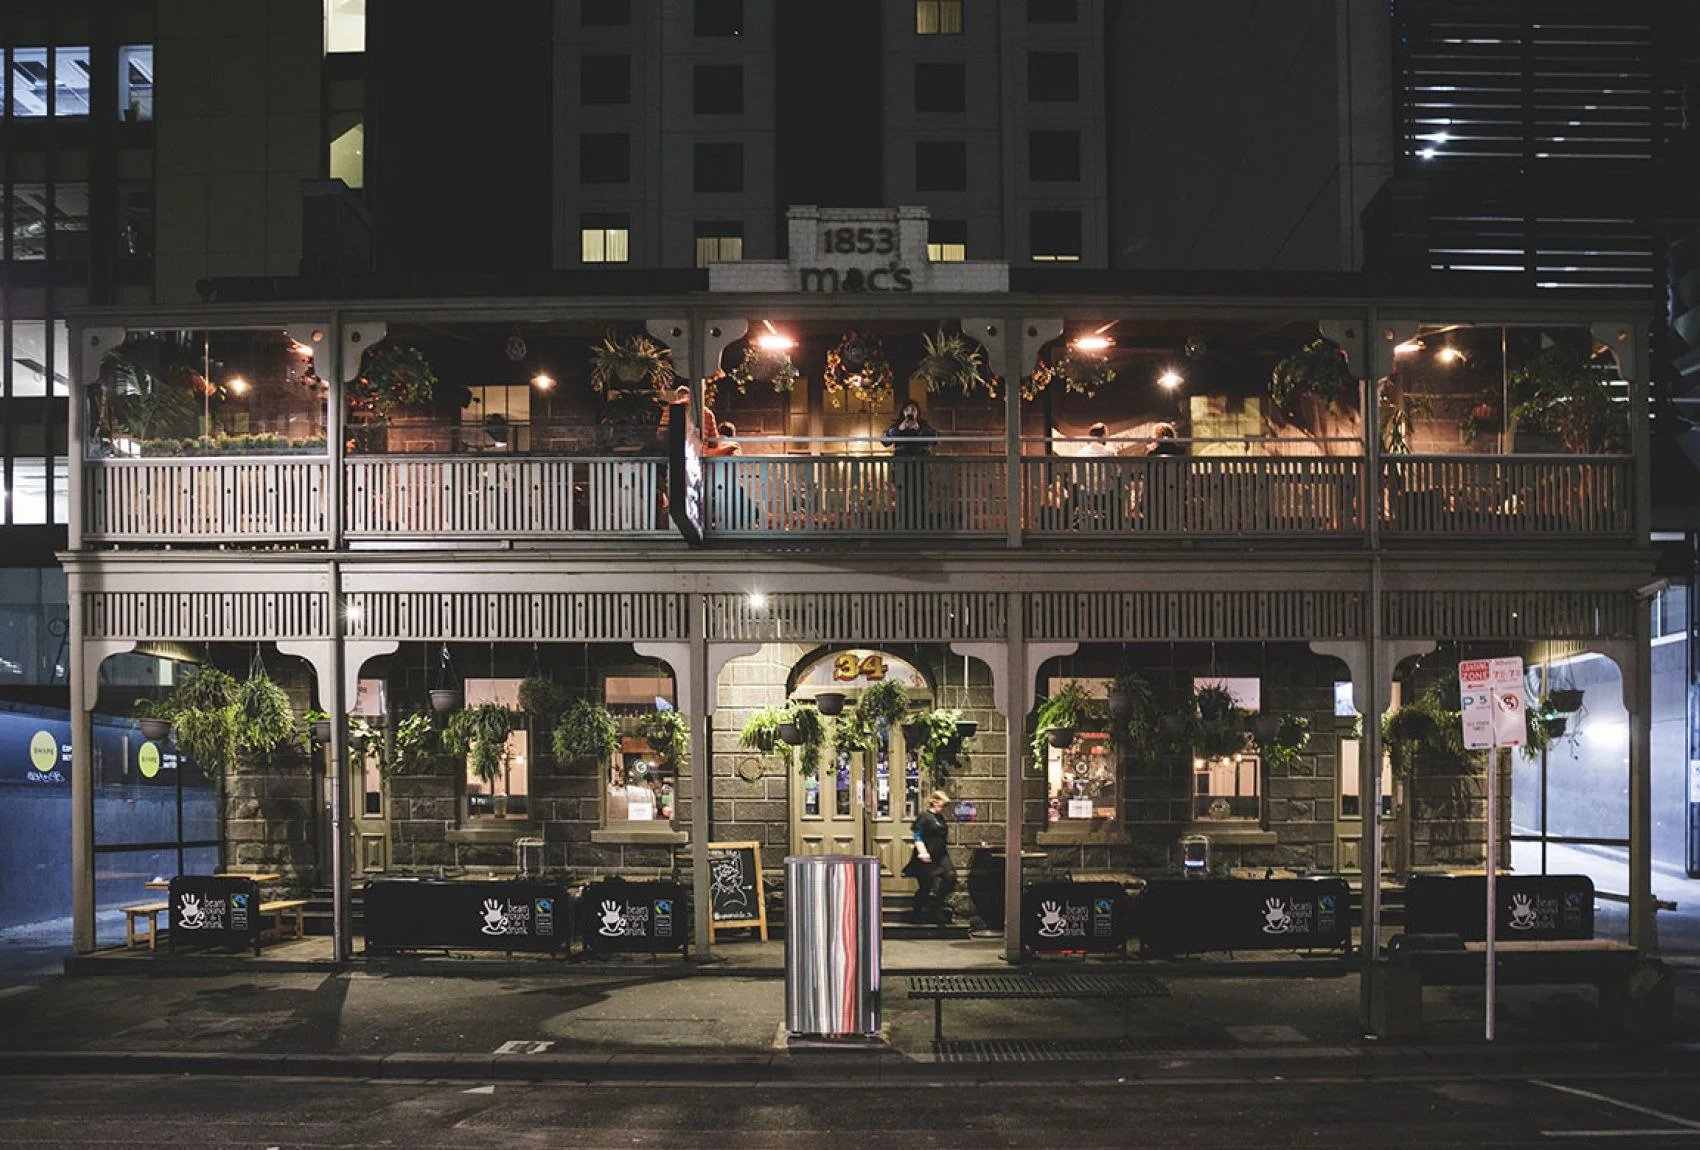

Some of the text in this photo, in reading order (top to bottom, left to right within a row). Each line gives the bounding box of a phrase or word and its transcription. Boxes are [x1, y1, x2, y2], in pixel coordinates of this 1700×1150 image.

[823, 228, 894, 254] 1853
[833, 655, 888, 681] 34
[1462, 672, 1488, 681] ZONE
[1462, 697, 1474, 710] P
